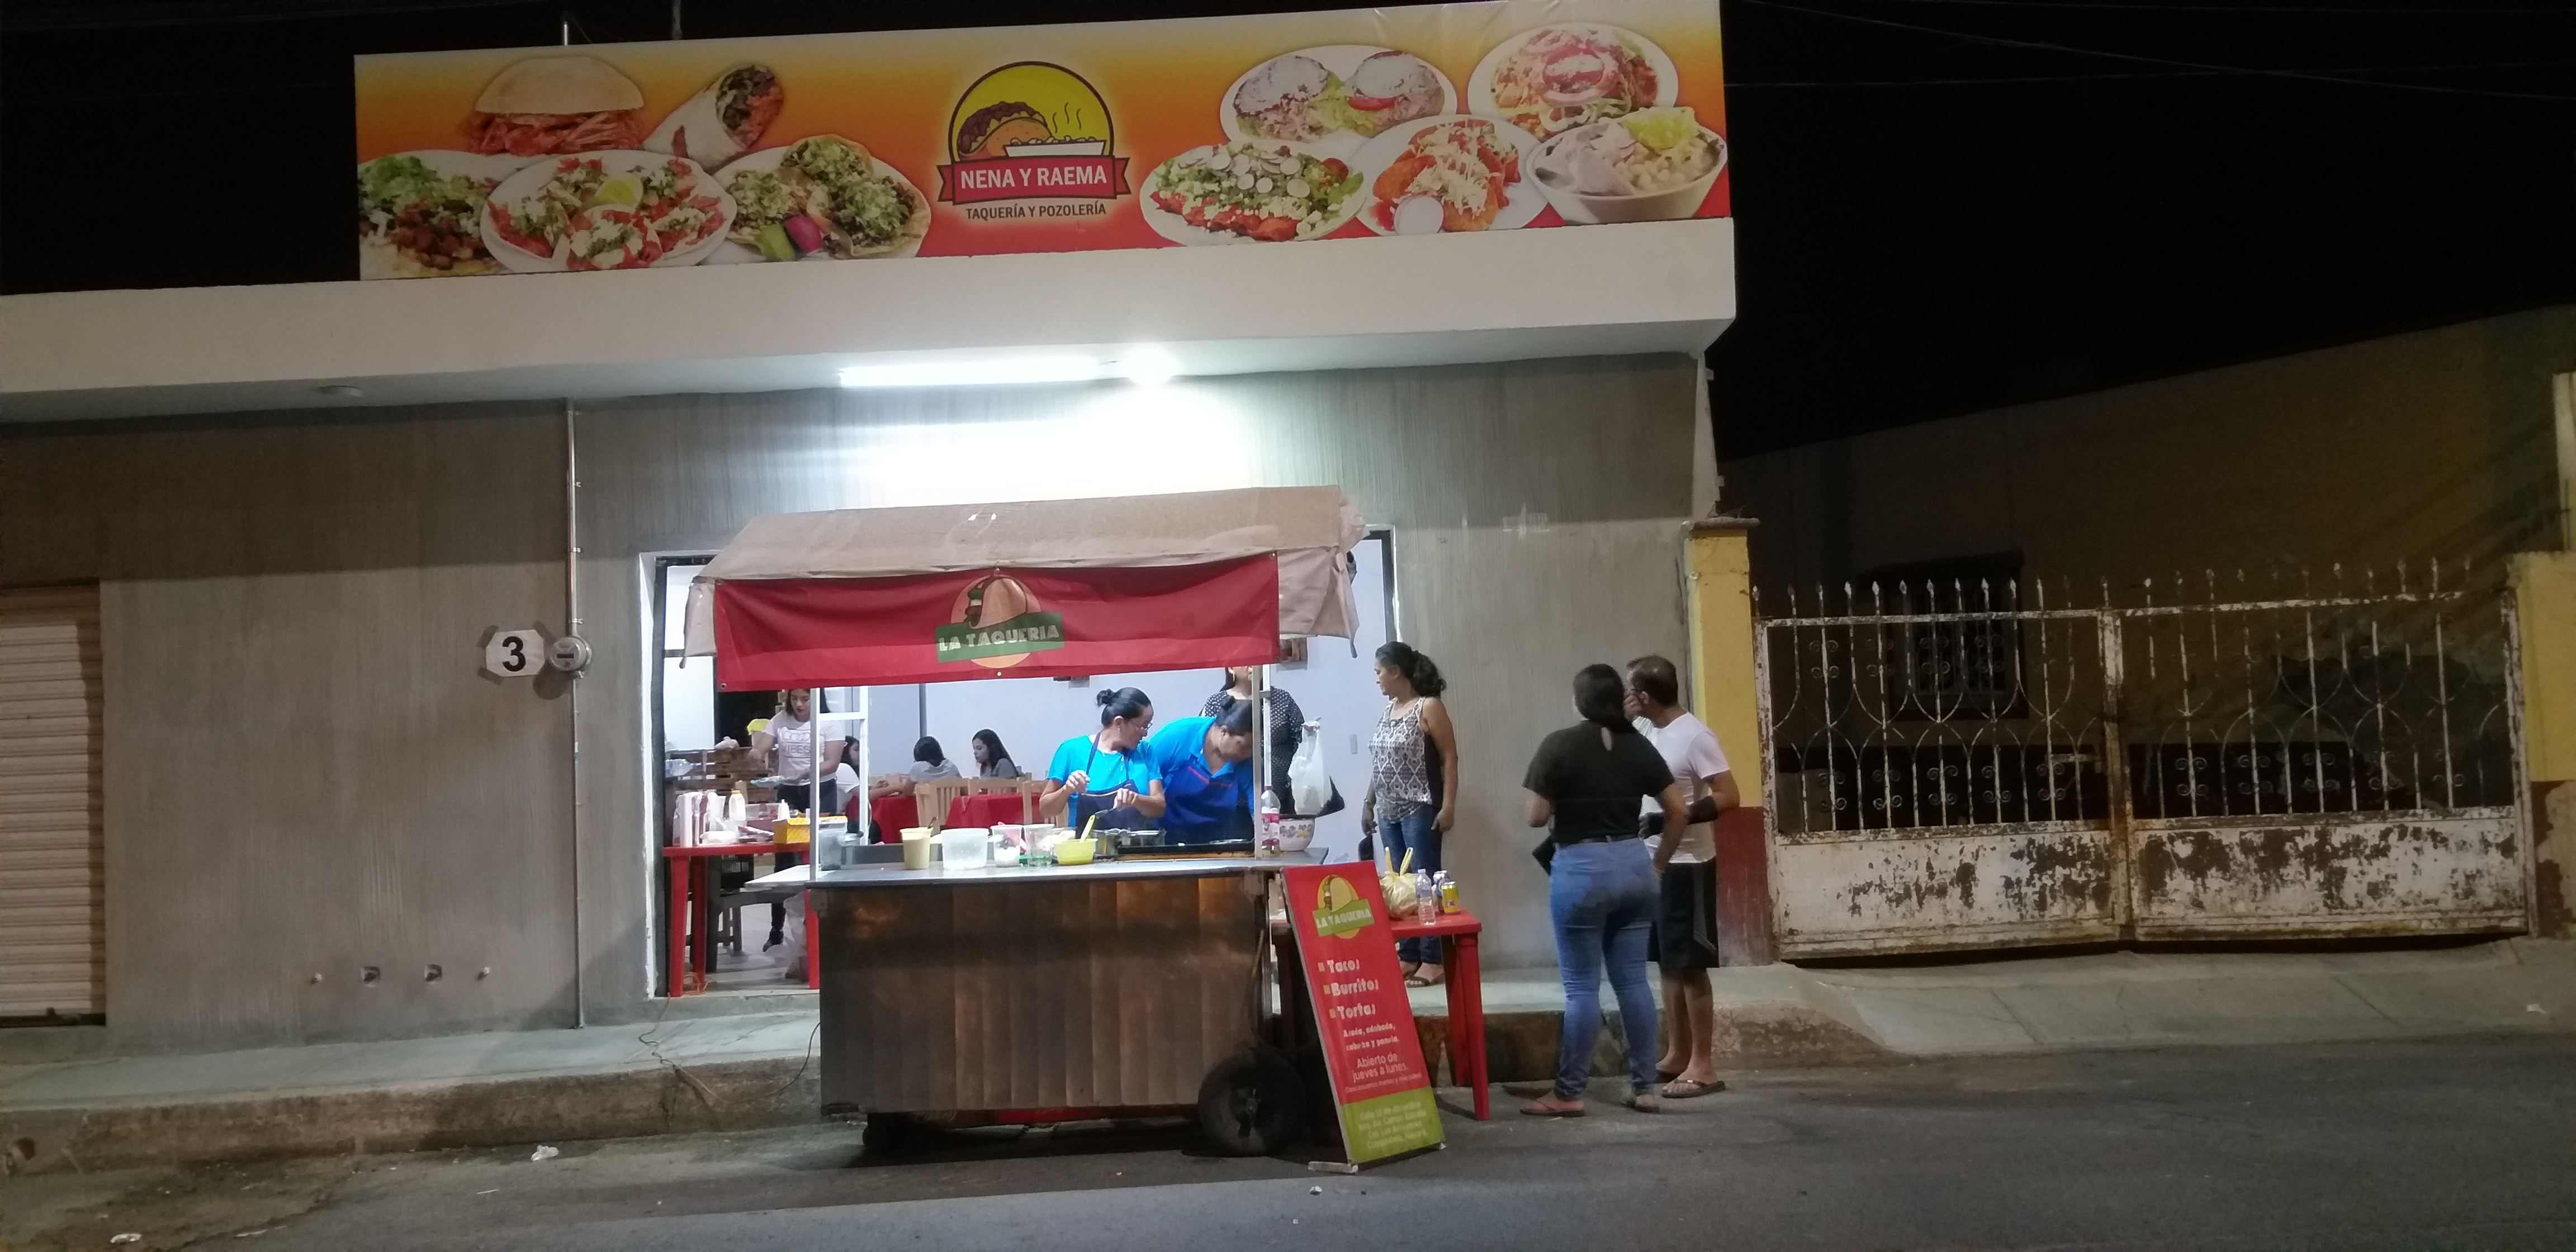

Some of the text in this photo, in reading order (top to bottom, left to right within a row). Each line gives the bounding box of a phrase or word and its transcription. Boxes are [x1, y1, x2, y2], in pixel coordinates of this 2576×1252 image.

[960, 165, 1107, 189] NENA Y RAEMA
[966, 200, 1106, 221] TAQUERÍA Y POZOLERÍA
[939, 625, 1060, 651] LA TAQUERIA
[503, 636, 526, 672] 3
[1316, 908, 1371, 928] LA TAQUERIA
[1327, 959, 1360, 973] Tacos
[1330, 978, 1379, 996] Burritos
[1337, 1003, 1376, 1019] Tortas
[1357, 1052, 1398, 1068] Abierto de
[1352, 1068, 1379, 1083] jueves
[1380, 1066, 1385, 1075] a
